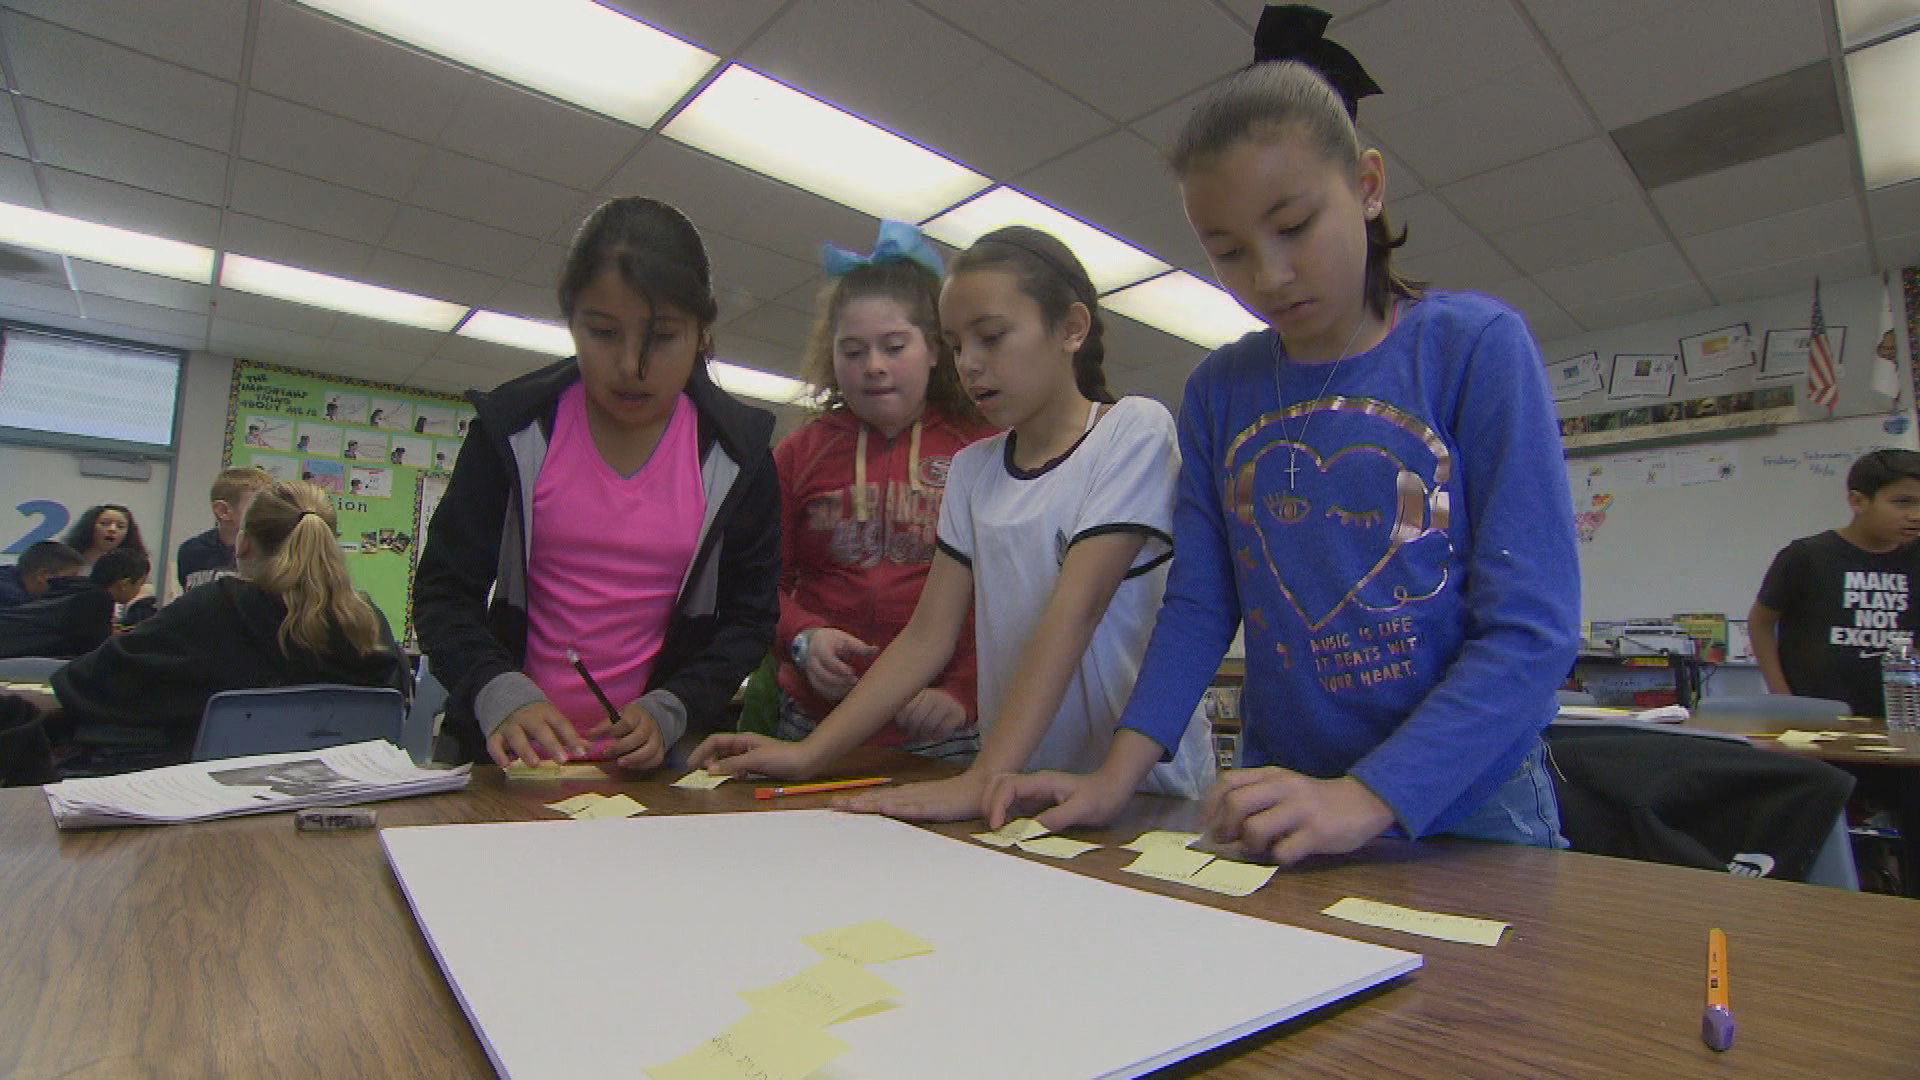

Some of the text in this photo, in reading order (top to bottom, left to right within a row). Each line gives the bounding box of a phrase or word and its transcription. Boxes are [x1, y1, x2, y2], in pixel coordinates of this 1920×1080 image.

[0, 500, 71, 553] 2
[1844, 571, 1909, 592] MAKE
[1843, 591, 1908, 611] PLAYS
[1855, 609, 1899, 629] NOT
[1310, 616, 1413, 653] MUSIC IS LIFE
[1315, 656, 1329, 673] IT
[1334, 646, 1382, 668] BEATS
[1320, 659, 1417, 693] YOUR HEART.
